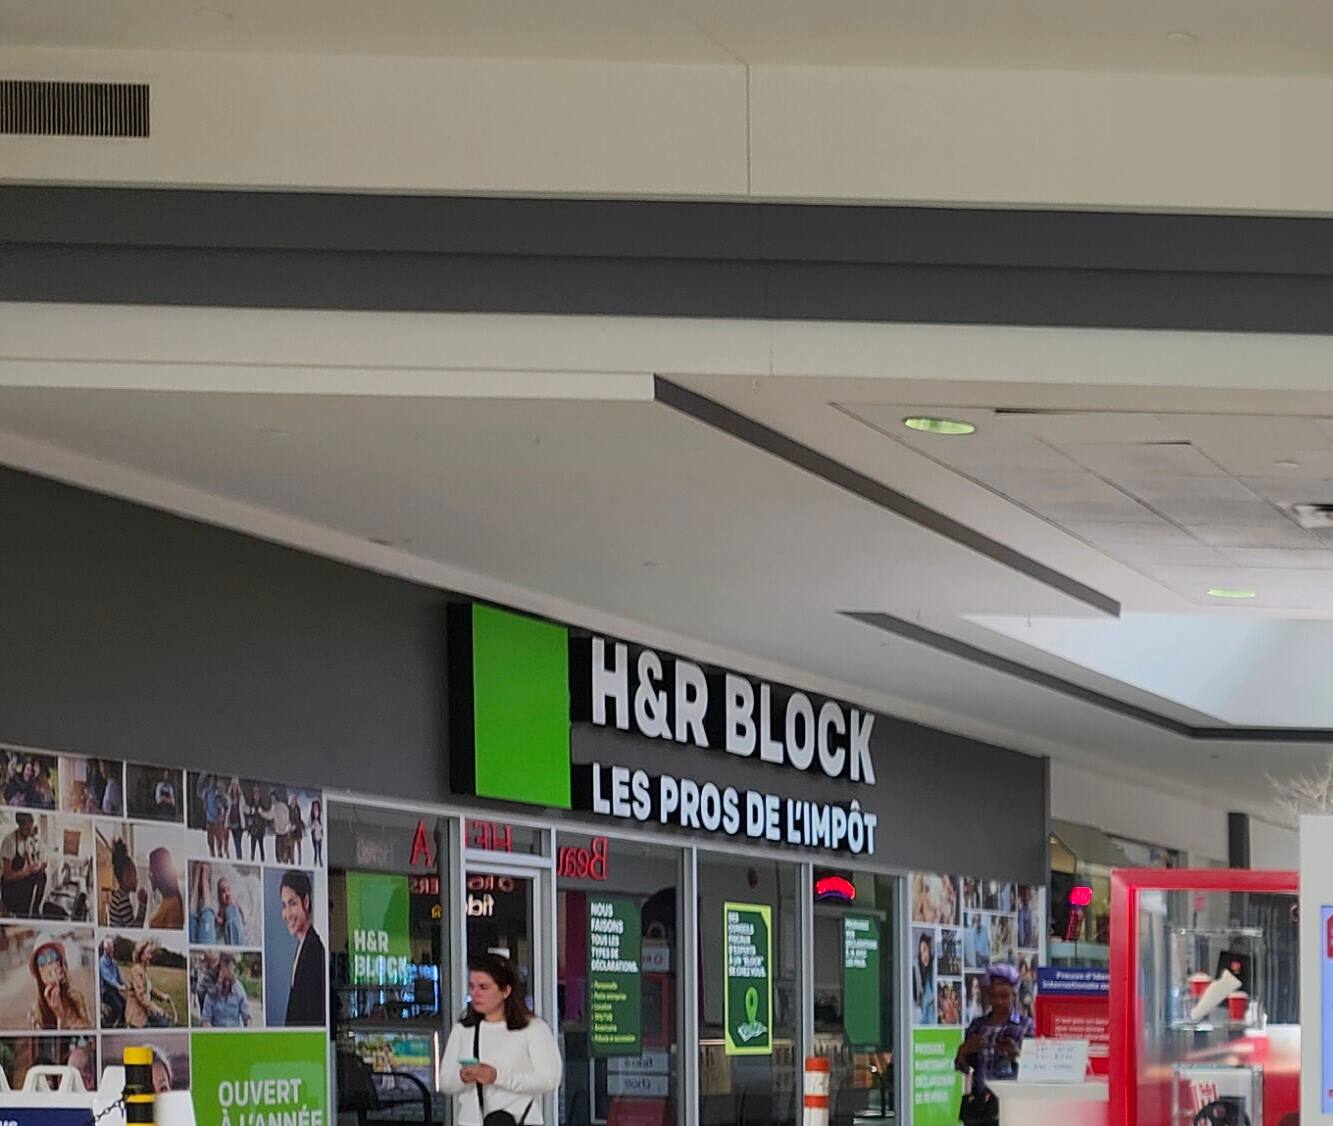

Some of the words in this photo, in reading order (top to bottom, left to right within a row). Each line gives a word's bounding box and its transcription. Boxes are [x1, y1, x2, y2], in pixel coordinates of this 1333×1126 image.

[592, 635, 709, 748] H&R
[725, 672, 876, 785] BLOCK
[592, 762, 651, 821] LES
[660, 773, 740, 835] PROS
[747, 789, 780, 841] DE
[787, 799, 877, 855] L'IMPÔT
[591, 902, 613, 917] NOUS
[591, 918, 624, 934] FAISONS
[354, 928, 389, 952] H&R
[591, 934, 608, 947] TOUS
[591, 947, 609, 959] TYPES
[610, 948, 619, 959] DE
[354, 954, 408, 979] BLOCK
[218, 1078, 302, 1107] OUVERT
